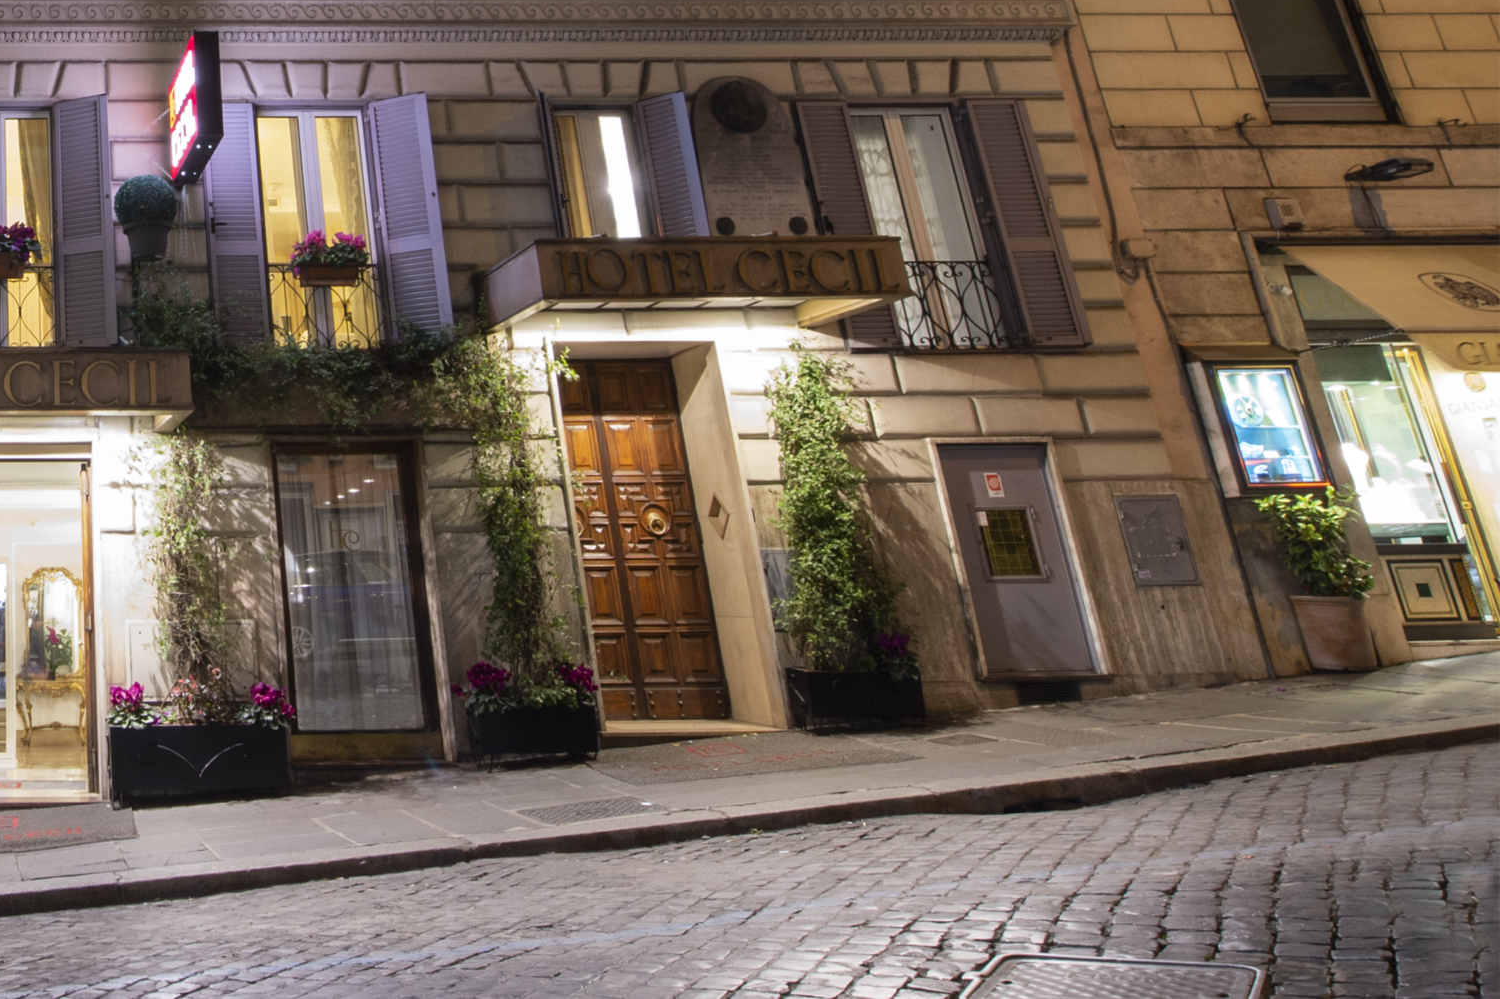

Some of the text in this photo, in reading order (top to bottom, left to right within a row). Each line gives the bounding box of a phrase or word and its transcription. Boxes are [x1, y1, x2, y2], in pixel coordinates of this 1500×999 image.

[556, 248, 901, 295] HOTEL CECIL
[1456, 341, 1500, 365] GI
[2, 359, 173, 407] CECIL
[3, 826, 91, 841] CECIL
